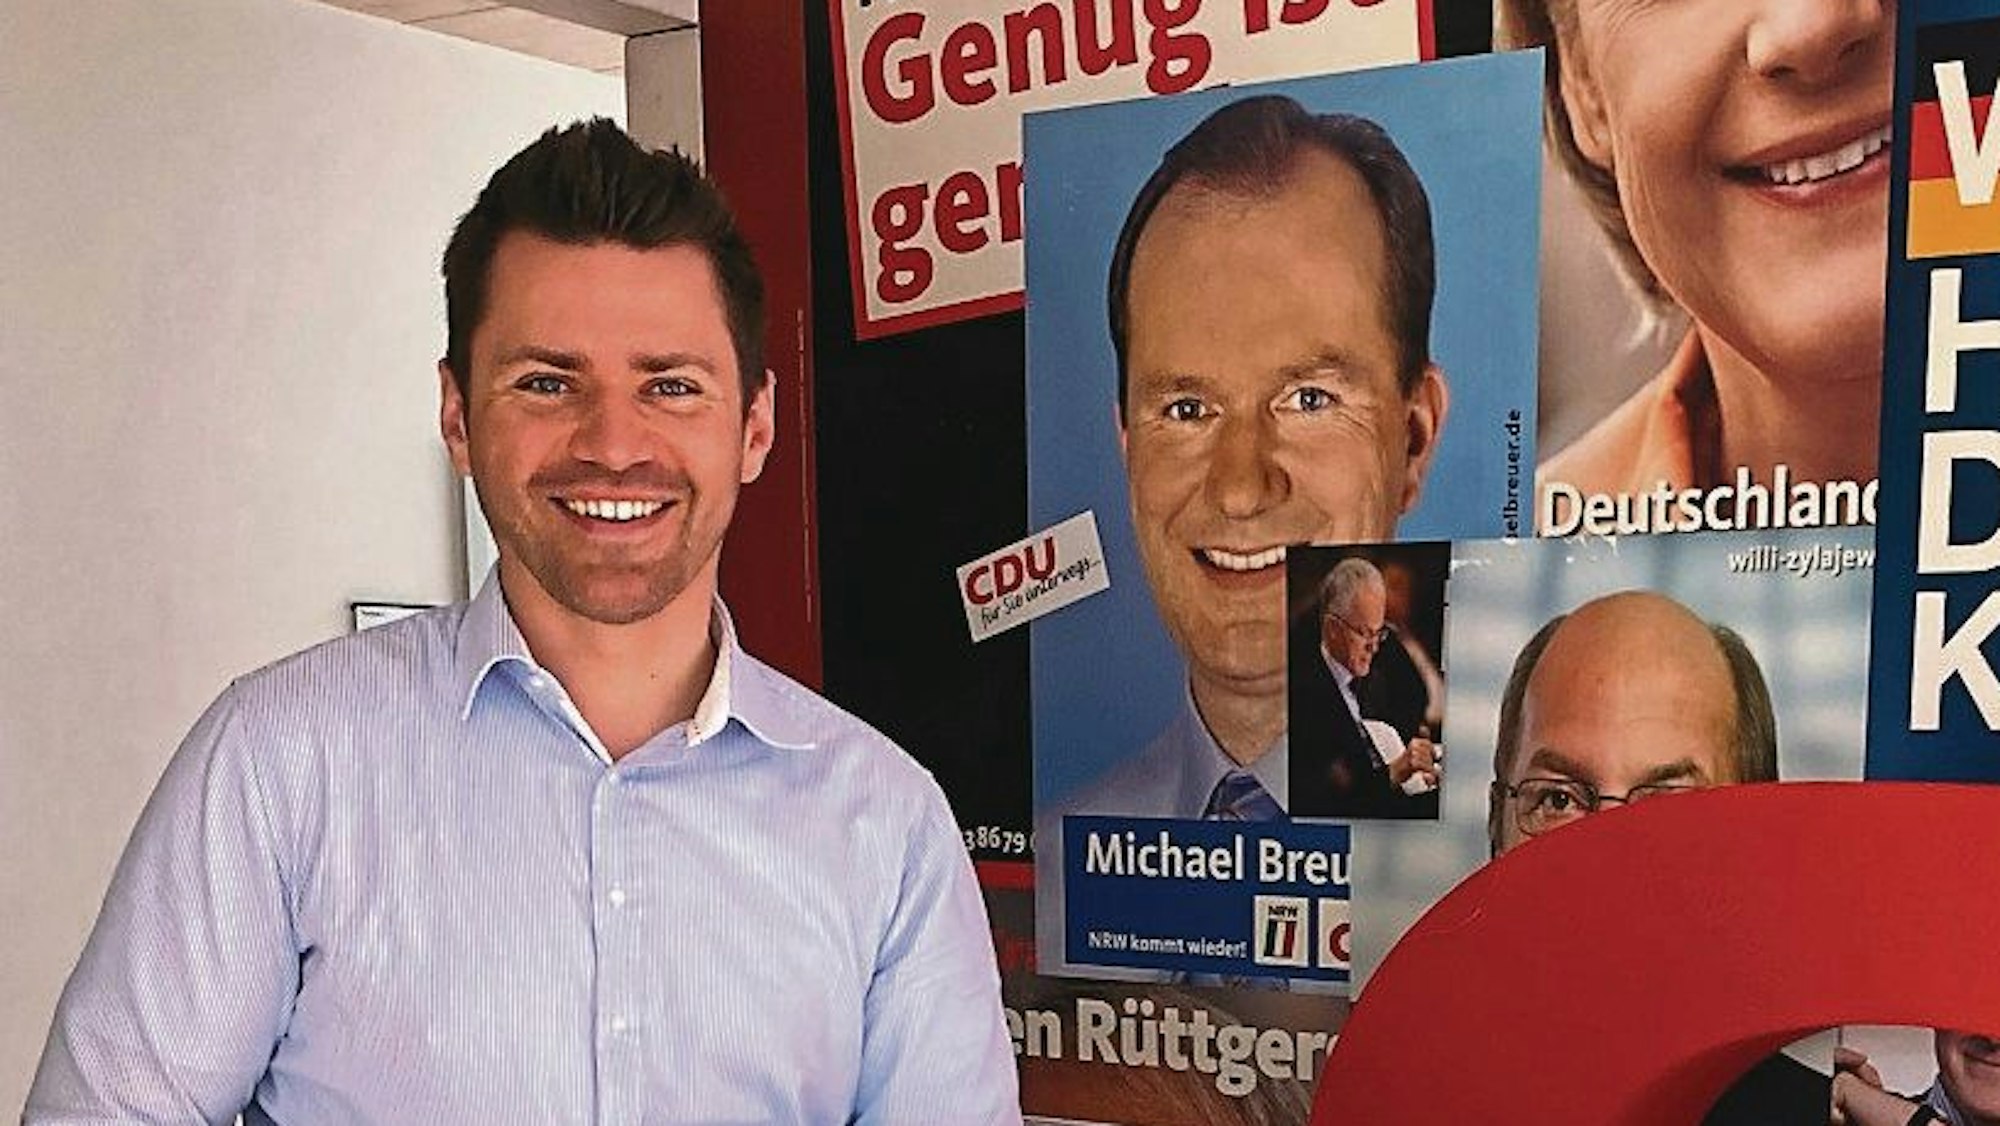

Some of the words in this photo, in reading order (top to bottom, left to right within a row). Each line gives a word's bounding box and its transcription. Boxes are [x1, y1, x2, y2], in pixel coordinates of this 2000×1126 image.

[862, 0, 1212, 123] Genug
[1917, 429, 2000, 574] D
[965, 536, 1056, 605] CDU
[1909, 590, 2000, 731] K
[1085, 830, 1245, 881] Michael
[1258, 838, 1351, 885] Breu
[1088, 931, 1128, 950] NRW
[1130, 934, 1184, 954] kommt
[1267, 904, 1299, 918] NRW
[1076, 997, 1338, 1096] Rüttger
